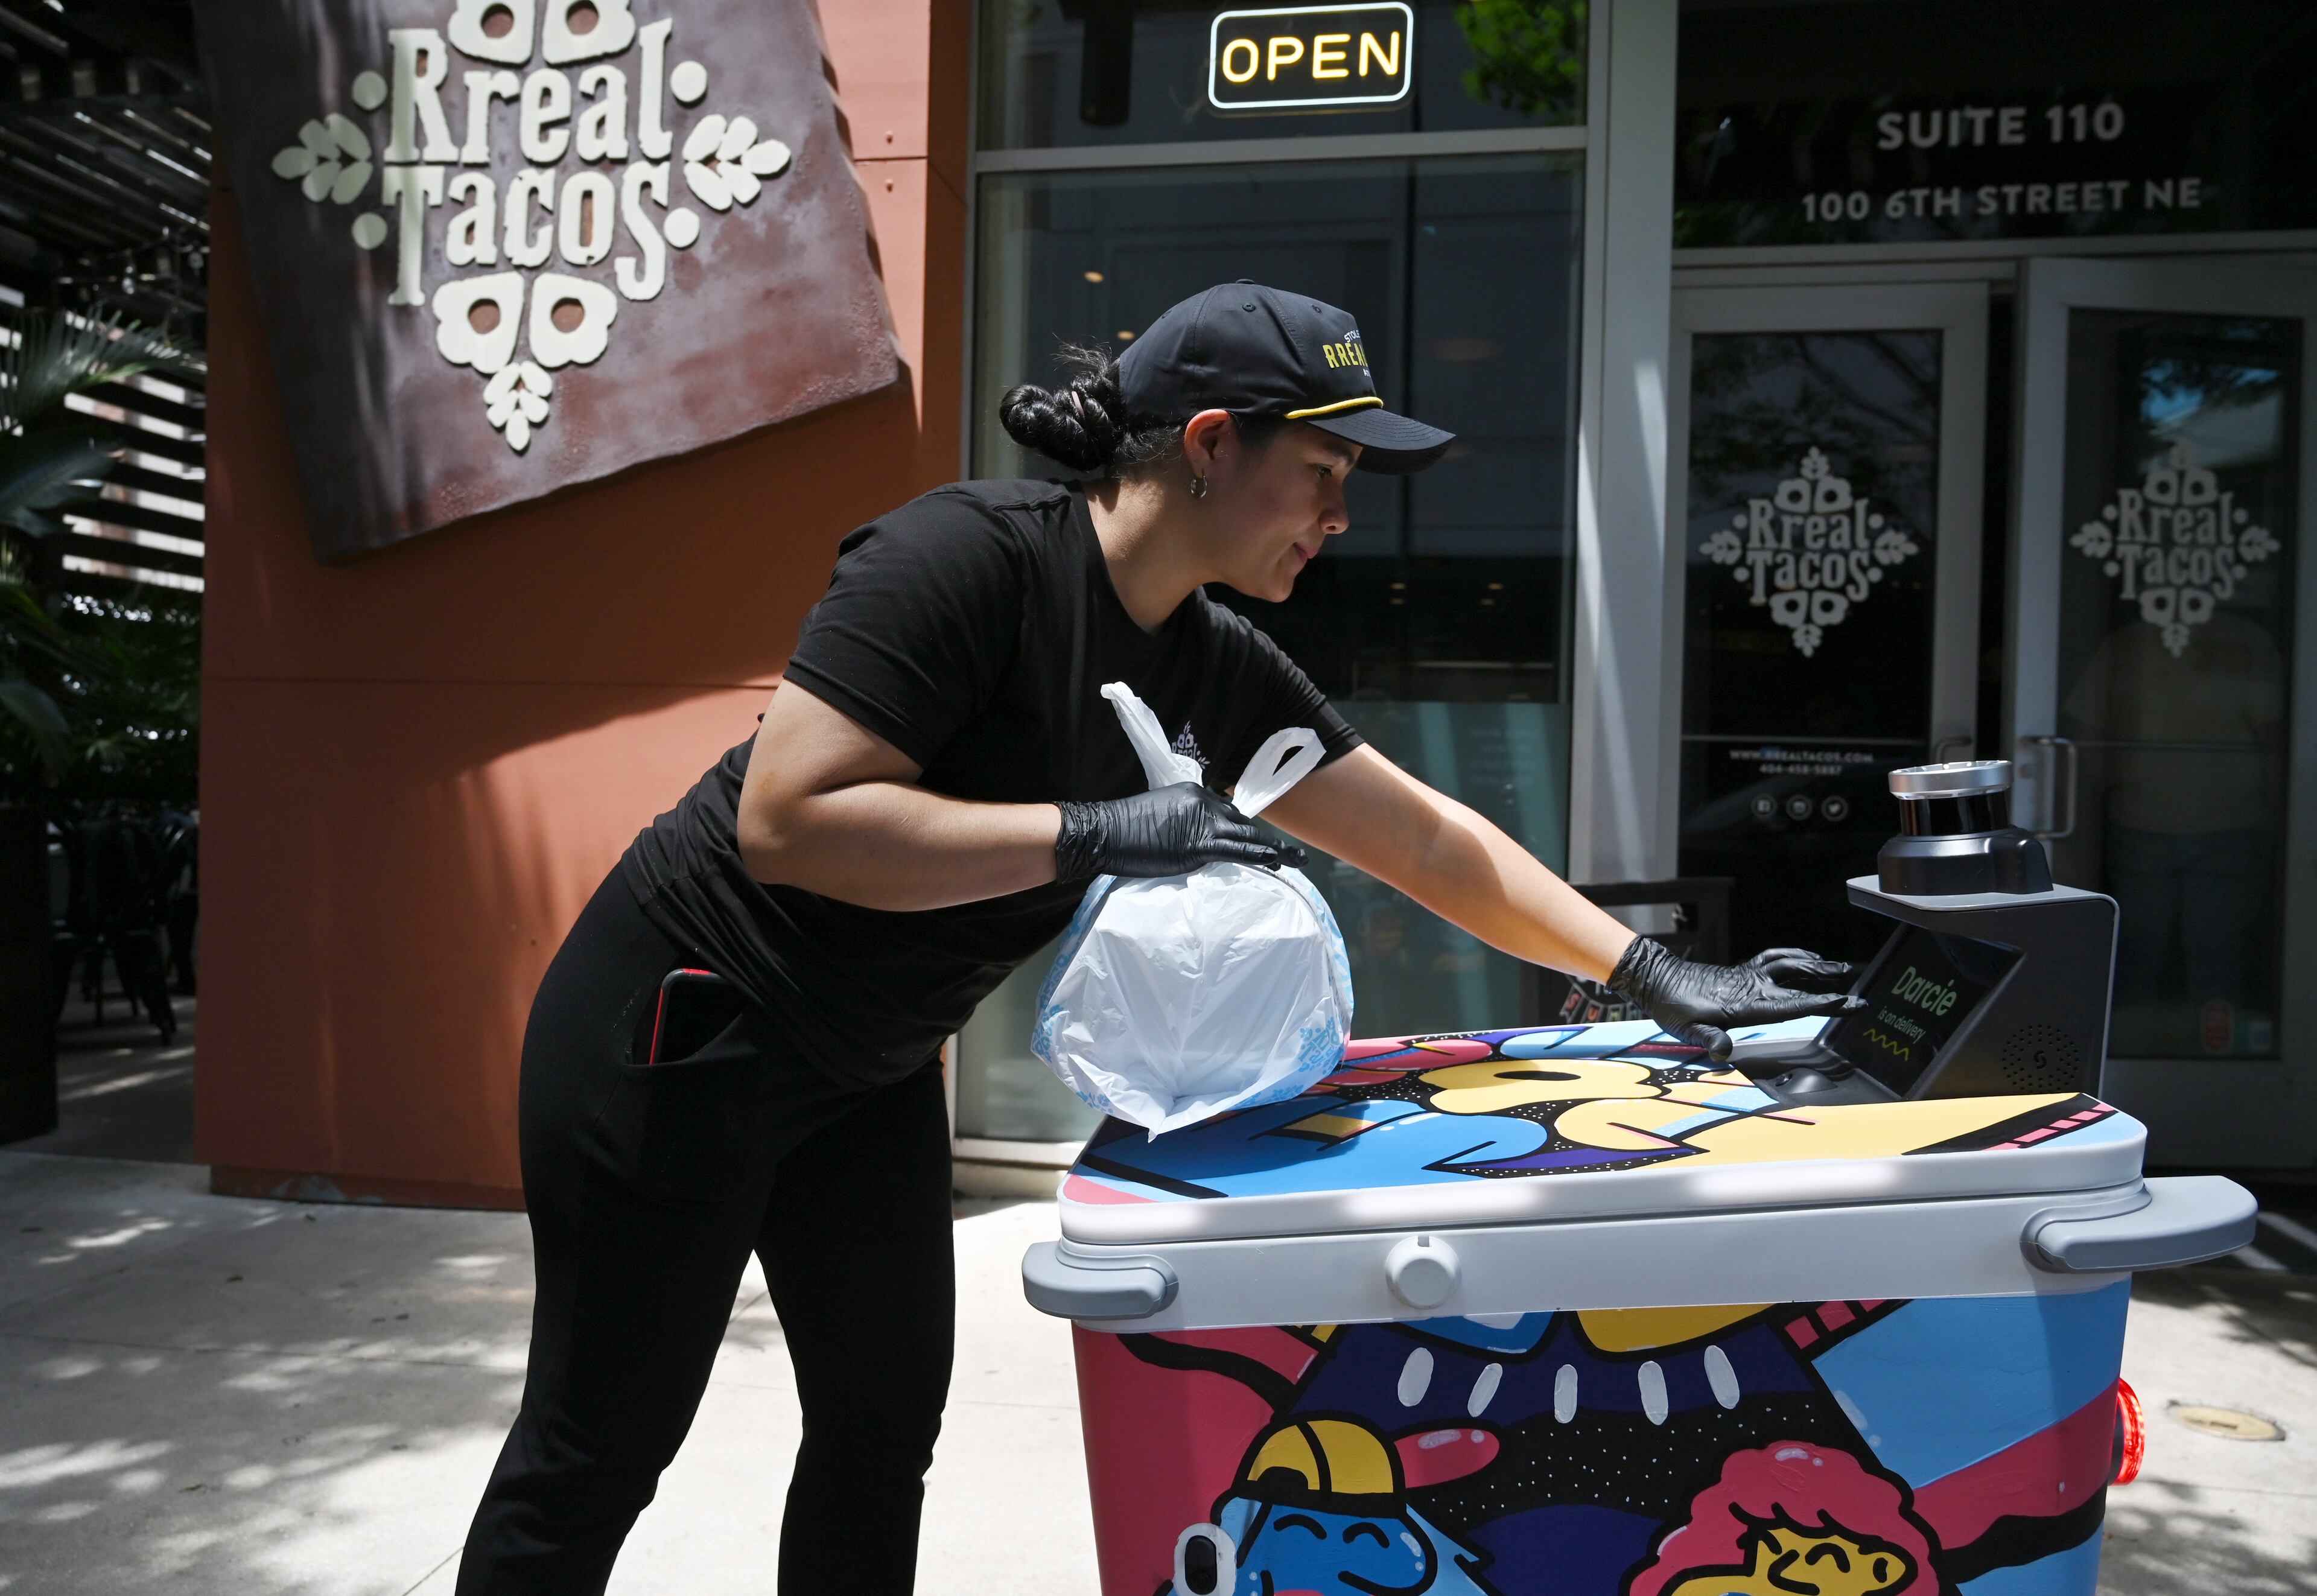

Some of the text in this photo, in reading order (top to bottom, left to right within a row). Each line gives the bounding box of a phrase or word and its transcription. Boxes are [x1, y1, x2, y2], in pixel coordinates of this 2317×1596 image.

[1221, 30, 1400, 83] OPEN
[383, 17, 673, 164] Rreal
[1877, 102, 2125, 150] SUITE 110
[1802, 177, 2202, 222] 100 6TH STREET NE
[383, 161, 671, 305] Tacos
[1747, 497, 1869, 550] Rreal
[2117, 488, 2234, 544] Rreal
[1746, 550, 1869, 606] Tacos
[2116, 544, 2234, 600] Tacos
[1891, 966, 1957, 1016] Darcie
[1877, 1005, 1927, 1044] is on delivery
